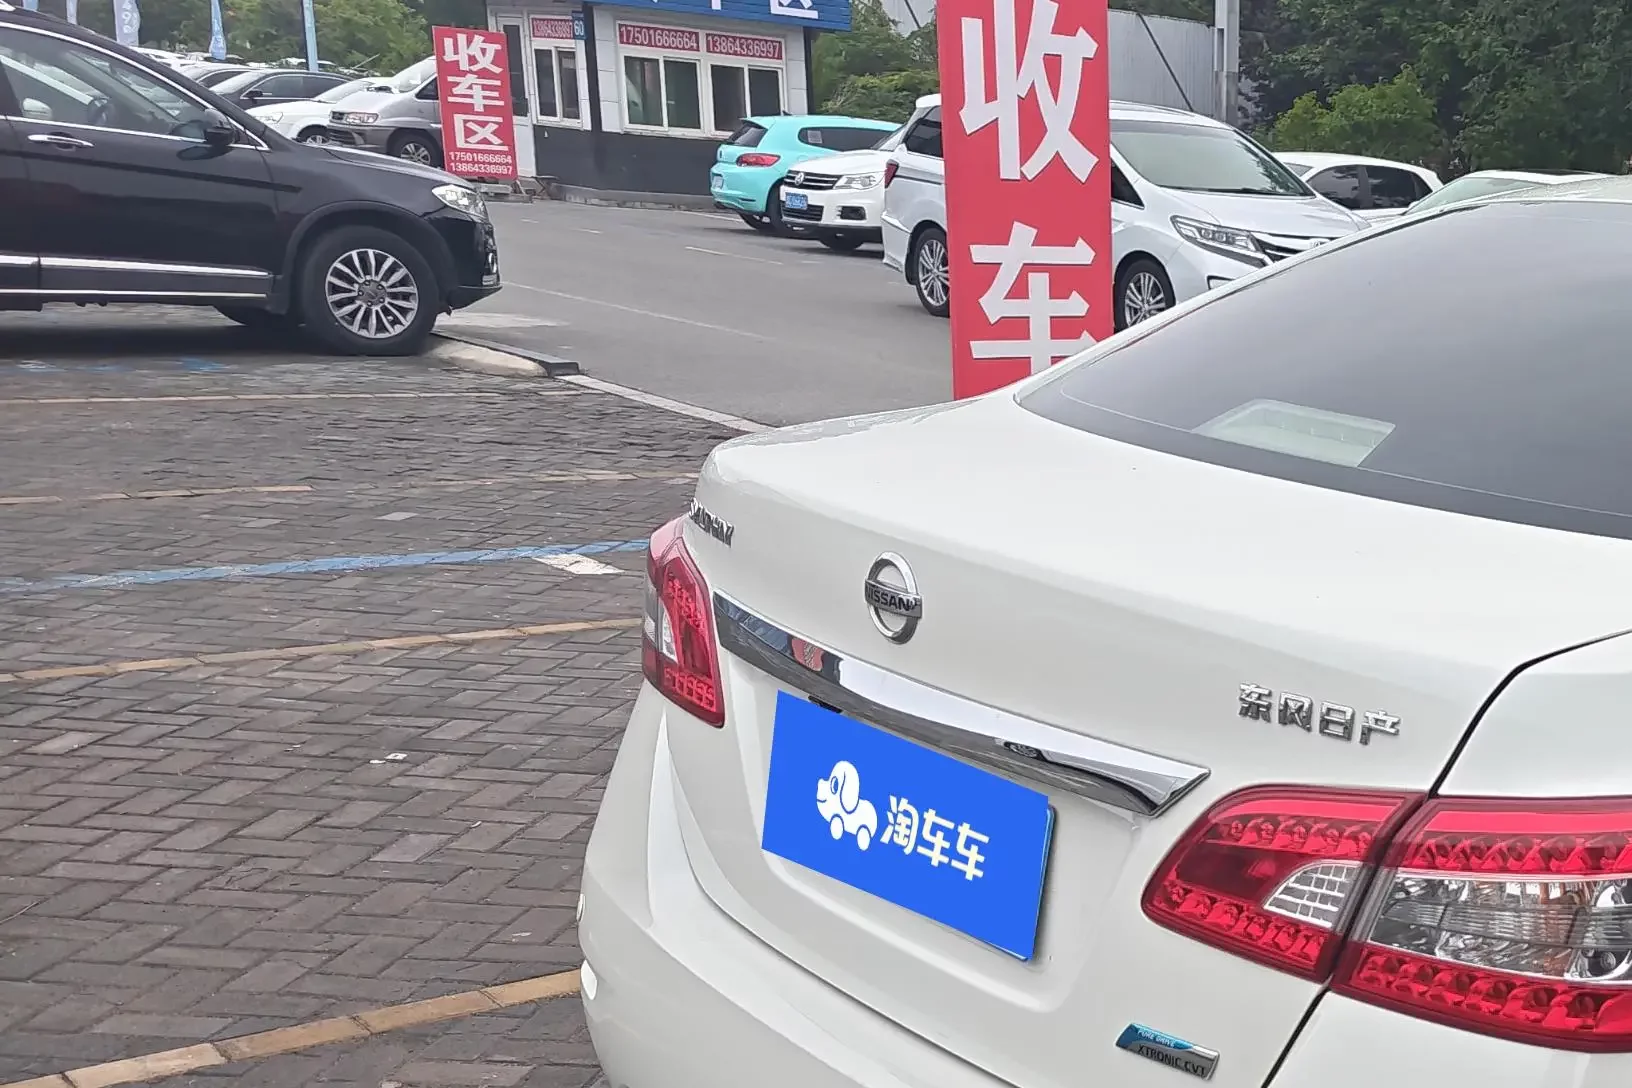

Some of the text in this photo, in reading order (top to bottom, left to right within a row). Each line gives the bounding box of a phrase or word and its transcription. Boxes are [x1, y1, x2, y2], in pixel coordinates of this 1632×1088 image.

[620, 26, 697, 49] 17501666664
[707, 36, 780, 58] 13864336997
[443, 33, 508, 151] 收车区
[449, 152, 512, 163] 17501666664
[959, 0, 1099, 376] 收车
[865, 582, 912, 612] NISSAN
[1238, 683, 1401, 745] 东风日产
[1138, 1044, 1206, 1077] XTRONIC CVT
